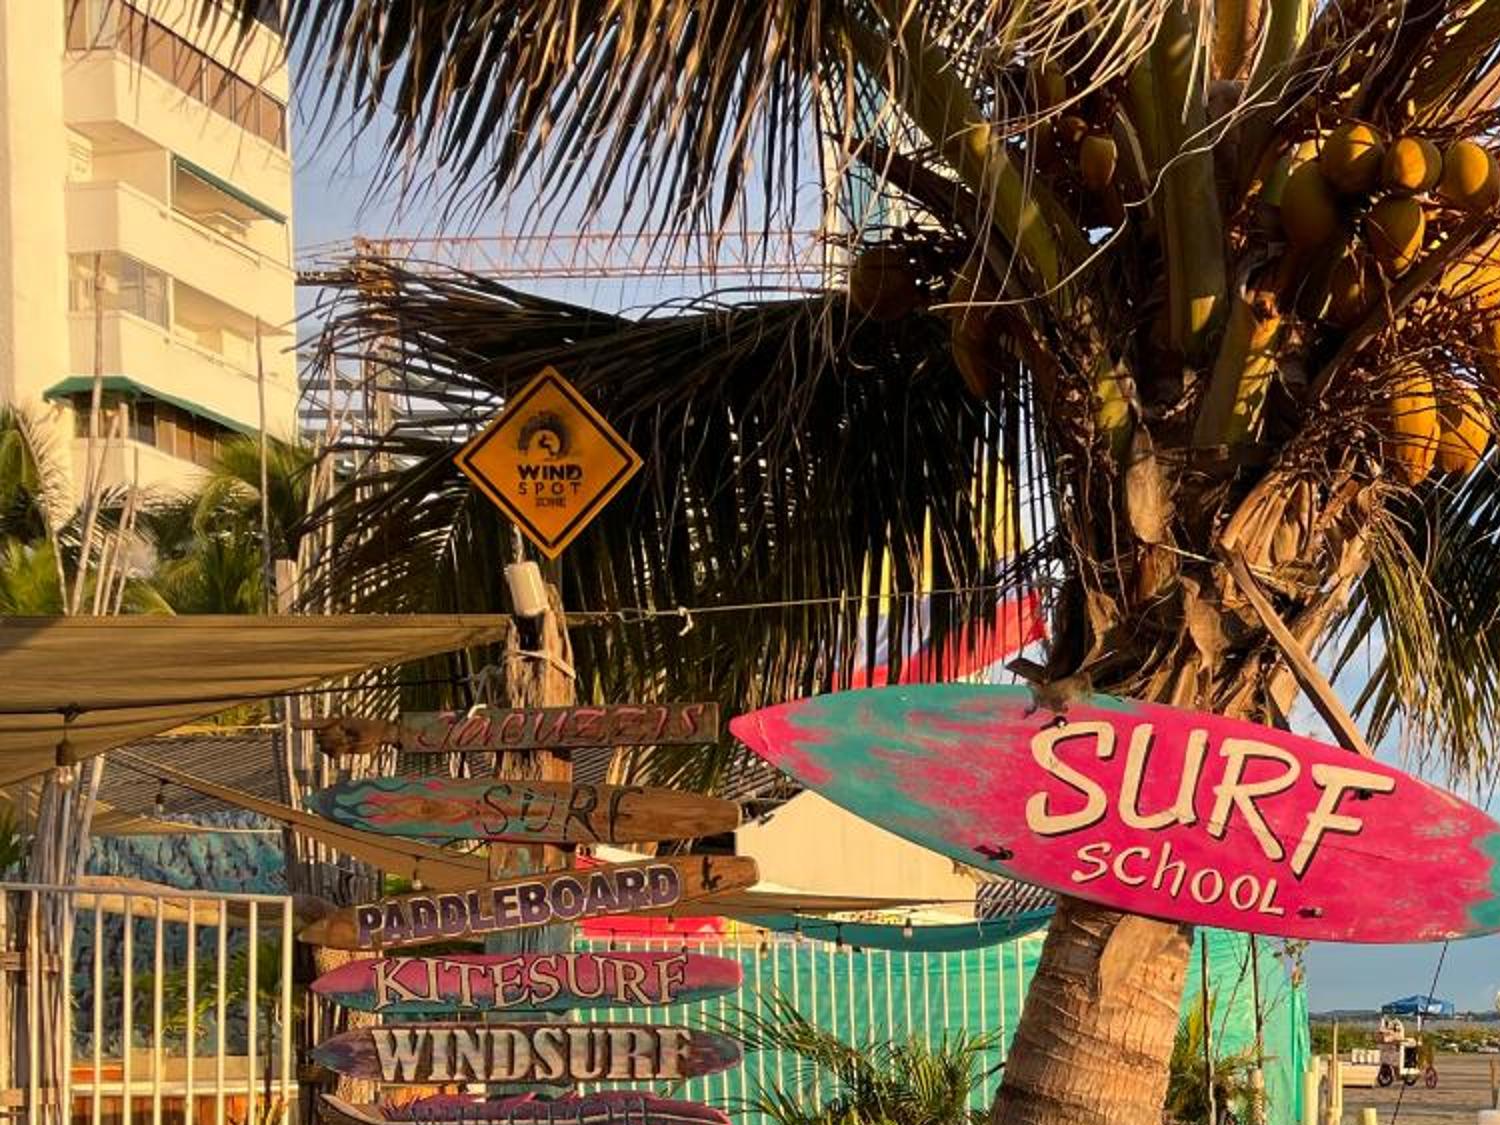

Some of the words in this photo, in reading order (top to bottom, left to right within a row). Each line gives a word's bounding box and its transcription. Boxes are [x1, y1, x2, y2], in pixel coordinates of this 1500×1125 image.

[517, 464, 582, 481] WIND
[518, 482, 581, 495] SPOT
[482, 783, 645, 842] SURF
[1022, 720, 1396, 878] SURF
[355, 863, 682, 948] PADDLEBOARD
[370, 951, 690, 1009] KITESURF
[370, 1027, 693, 1081] WINDSURF
